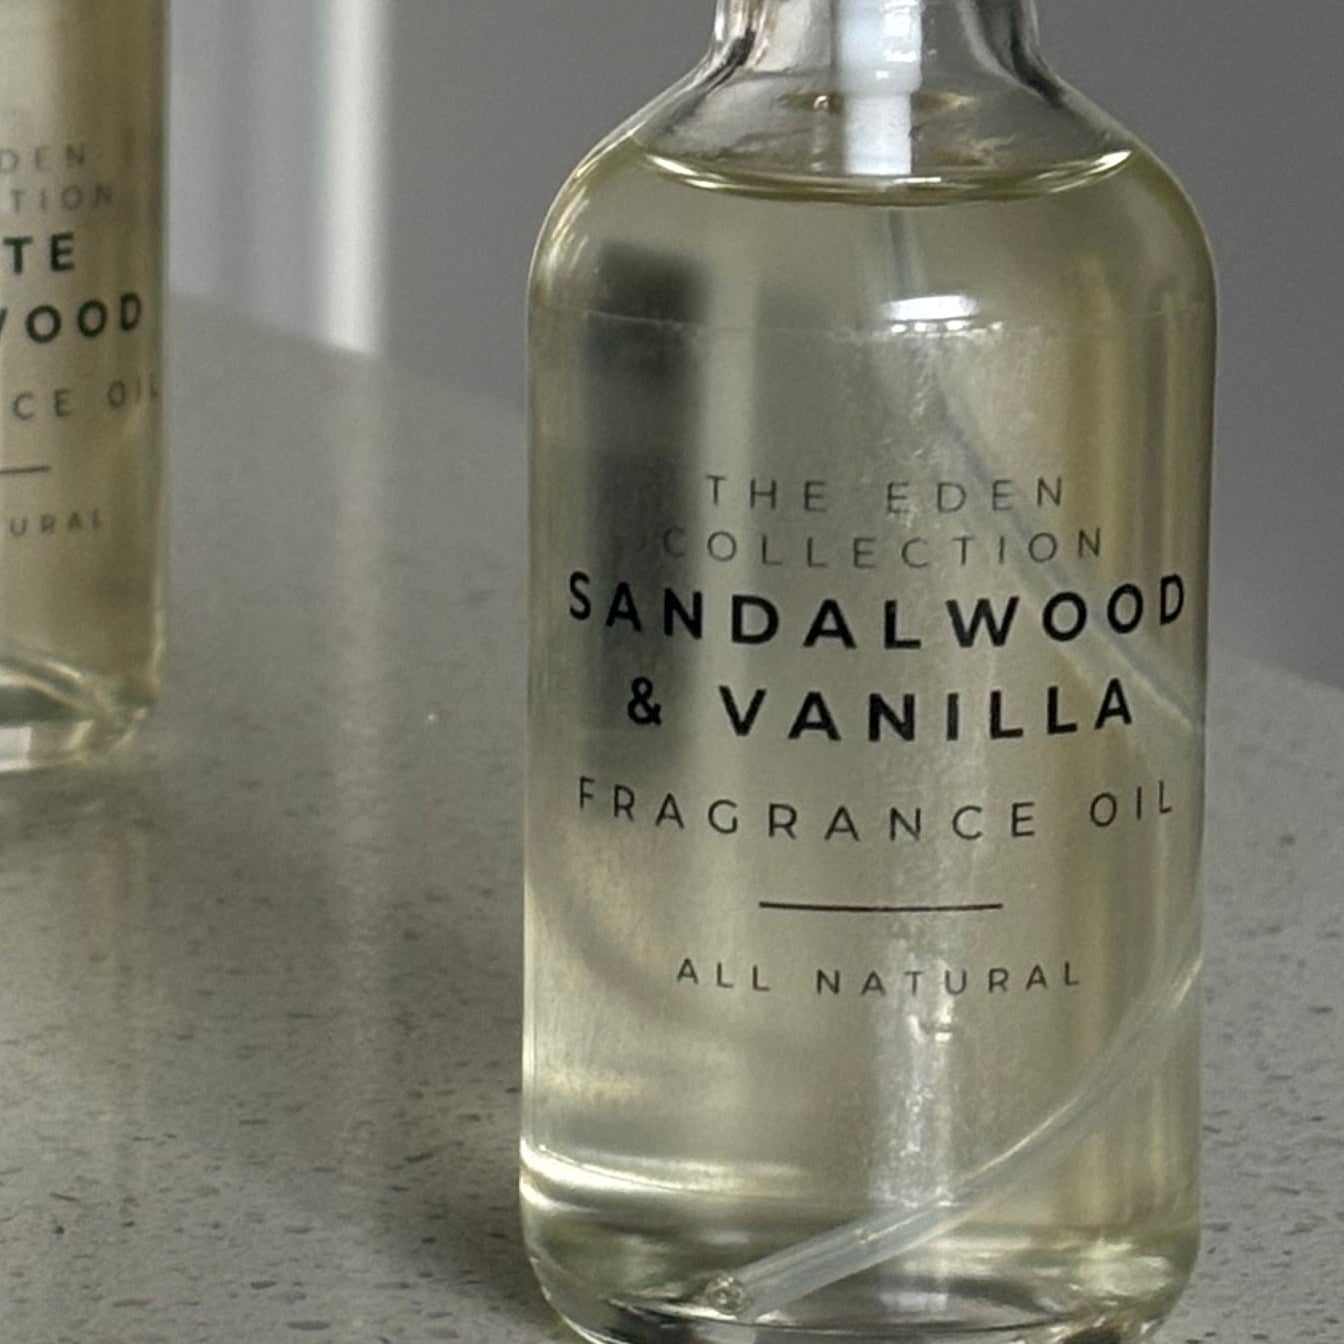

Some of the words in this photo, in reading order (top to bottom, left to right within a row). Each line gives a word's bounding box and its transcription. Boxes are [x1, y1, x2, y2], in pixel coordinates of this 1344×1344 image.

[705, 474, 828, 513] THE
[885, 475, 1064, 515] EDEN
[661, 526, 1103, 571] COLLECTION
[568, 570, 1186, 651] SANDALWOOD
[625, 676, 664, 728] &
[718, 678, 1135, 743] VANILLA
[578, 775, 1036, 842] FRAGRANCE
[1088, 779, 1174, 829] OIL
[676, 957, 771, 994] ALL
[815, 960, 1080, 998] NATURAL
